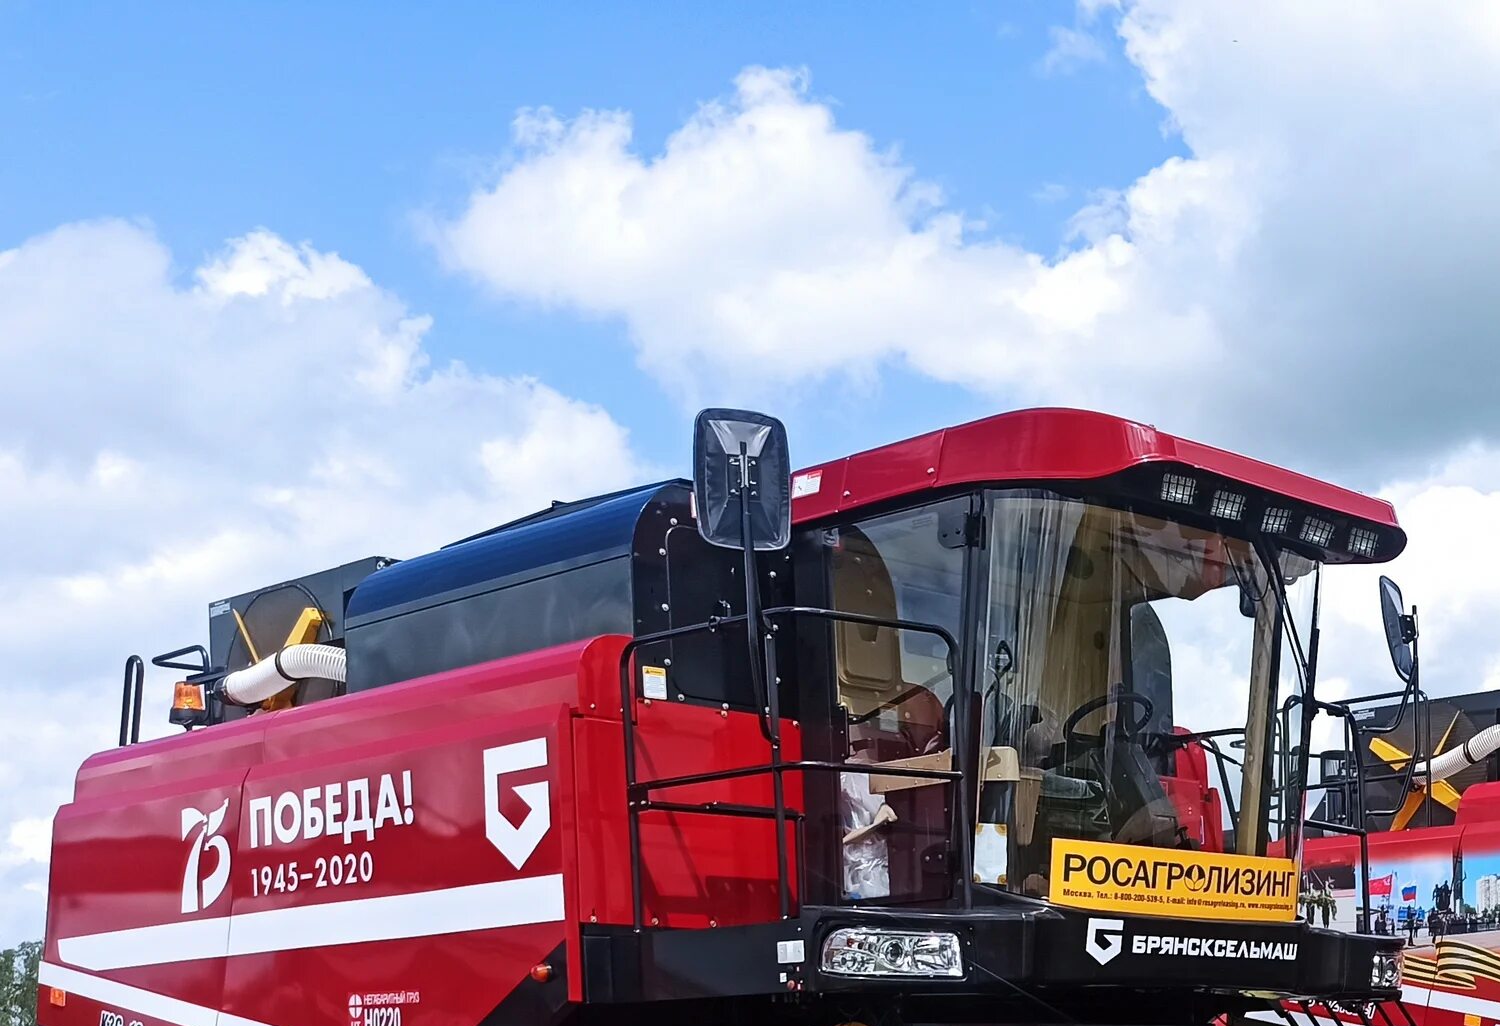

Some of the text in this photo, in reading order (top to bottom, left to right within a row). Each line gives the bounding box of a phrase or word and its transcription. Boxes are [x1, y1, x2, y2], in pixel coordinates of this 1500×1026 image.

[250, 769, 414, 849] ПОБЕДА!
[251, 851, 373, 897] 1945-2020
[1062, 853, 1295, 898] РОСАГРОЛИЗИНГ
[1063, 888, 1094, 899] Москва,
[1131, 935, 1298, 961] БРЯНСКСЕЛЬМАШ
